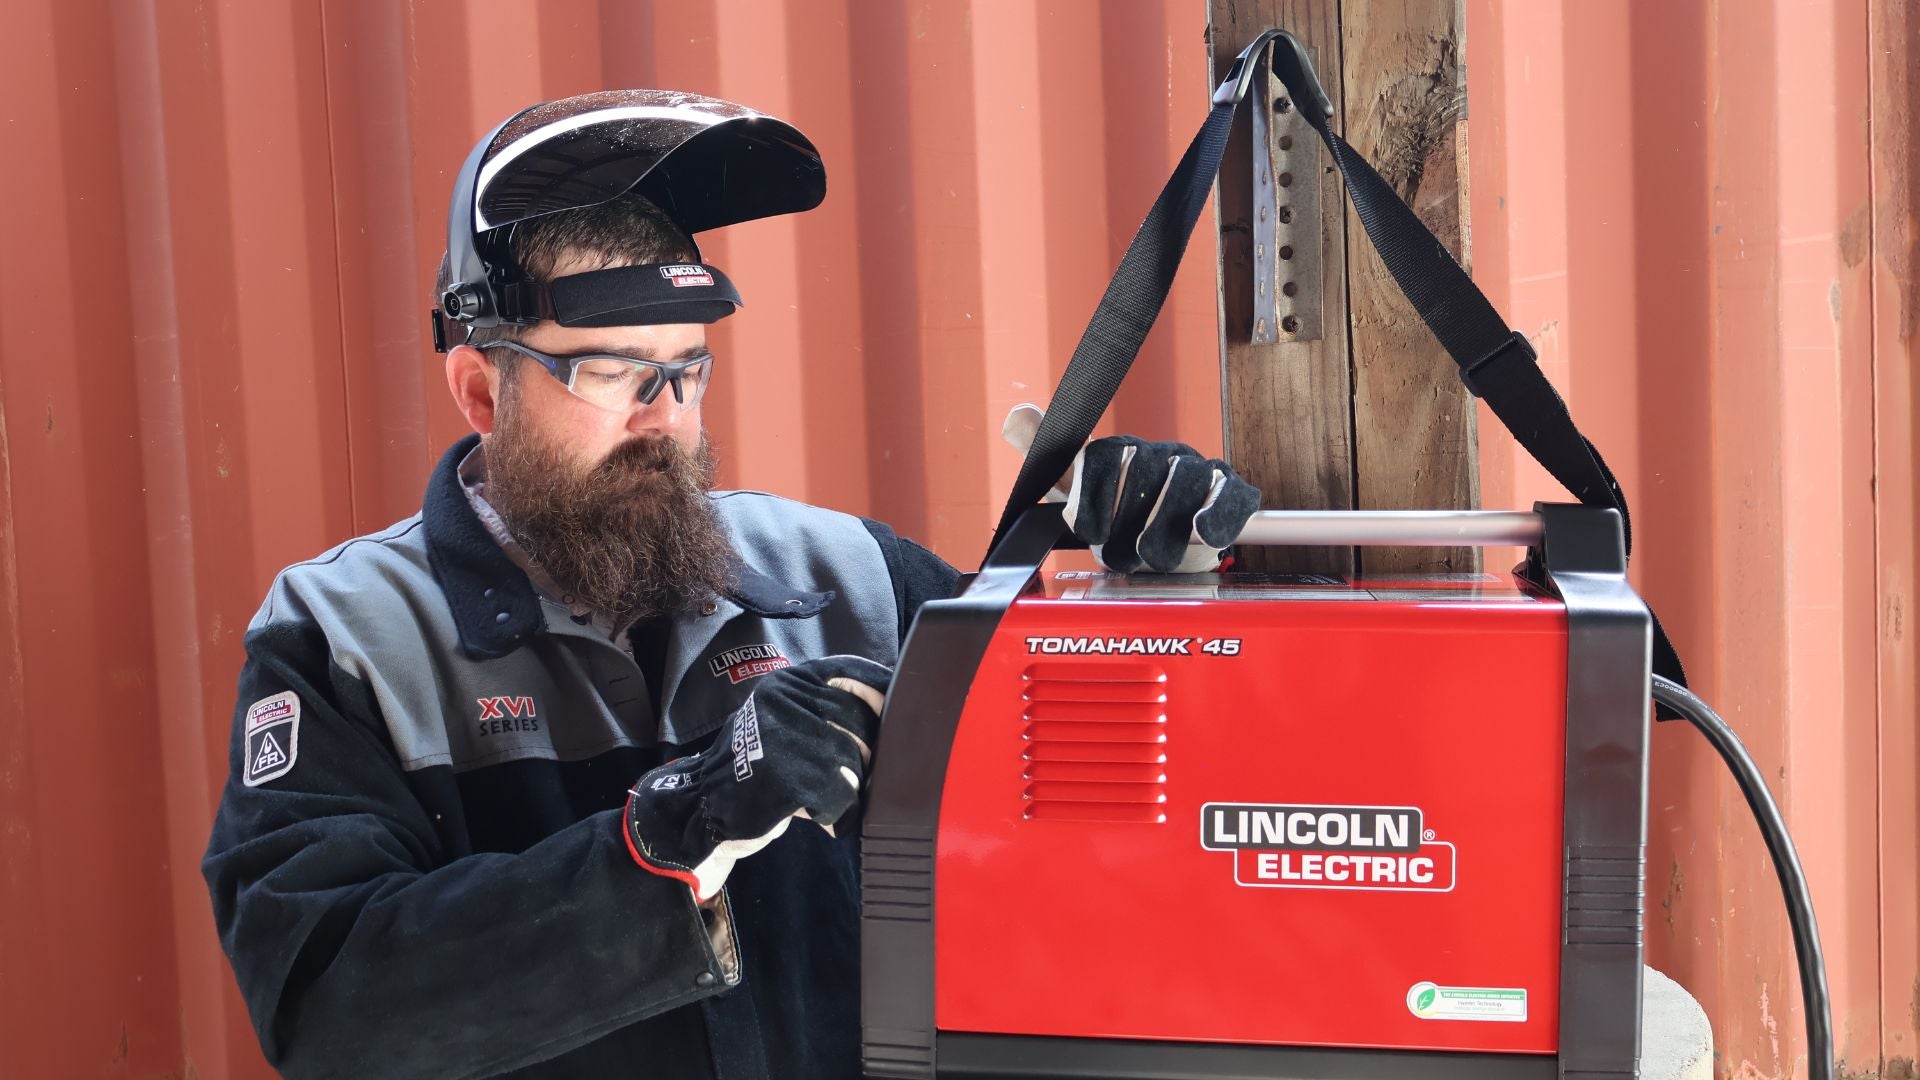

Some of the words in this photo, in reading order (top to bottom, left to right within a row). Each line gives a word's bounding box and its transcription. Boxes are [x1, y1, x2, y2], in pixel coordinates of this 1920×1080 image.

[662, 267, 704, 277] LINCOLN
[678, 277, 711, 285] ELECTRIC
[1024, 636, 1193, 656] TOMAHAWK
[1201, 638, 1243, 656] 45
[713, 645, 778, 671] LINCOLN
[252, 700, 285, 718] LINCOLN
[258, 707, 289, 722] ELECTRIC
[477, 696, 537, 720] XVI
[479, 719, 540, 737] SERIES
[258, 751, 279, 769] FR
[1213, 810, 1409, 847] LINCOLN
[1257, 853, 1434, 884] ELECTRIC
